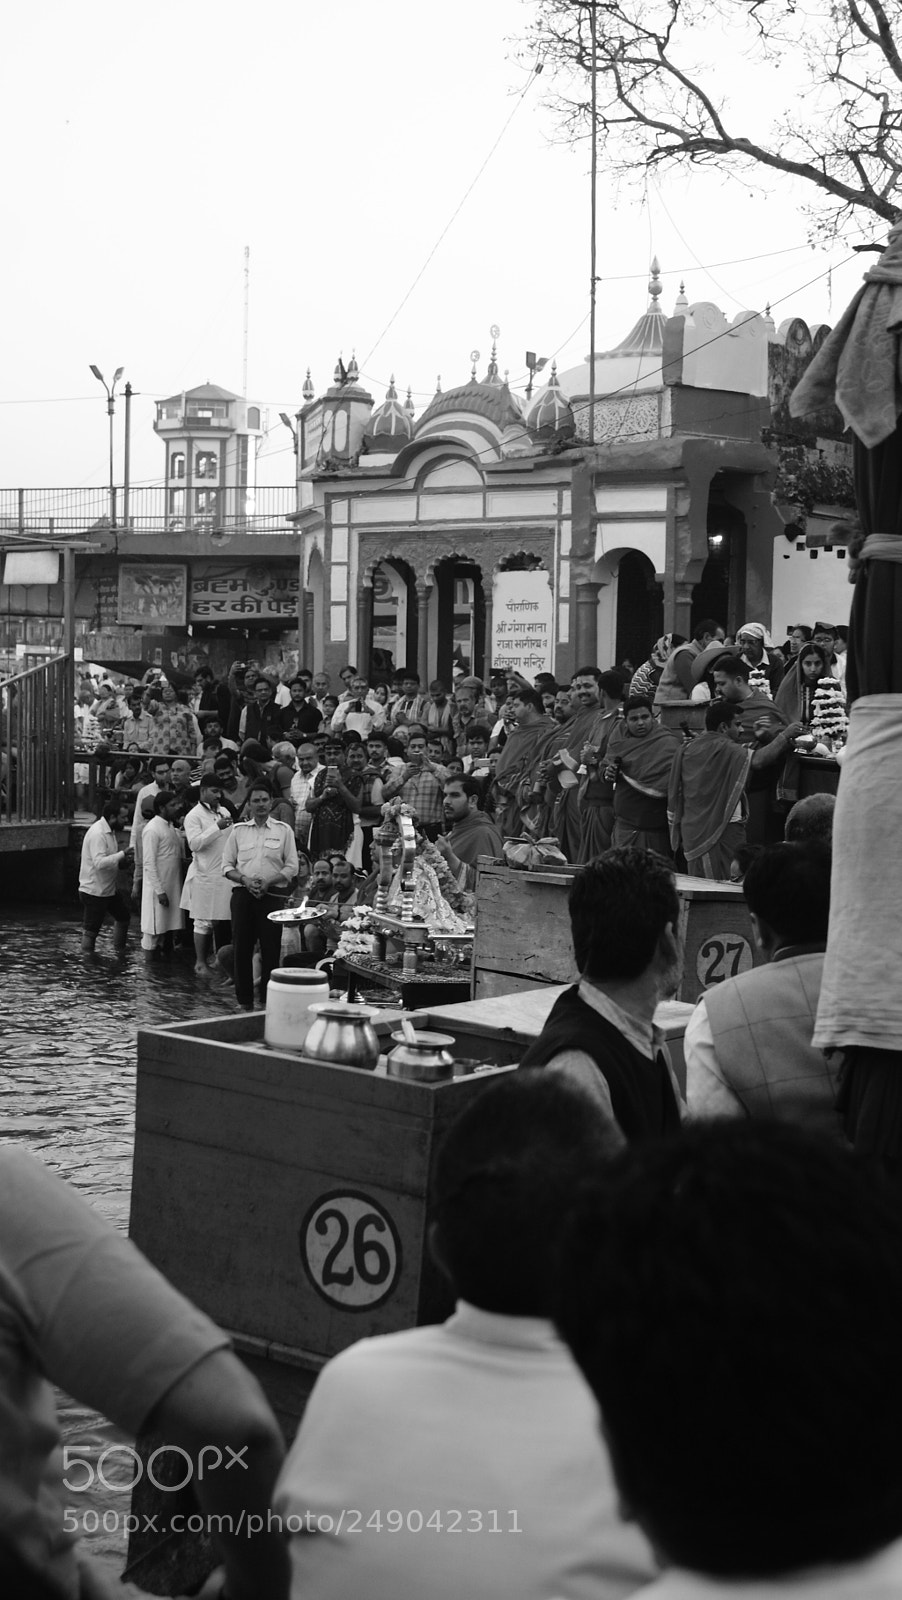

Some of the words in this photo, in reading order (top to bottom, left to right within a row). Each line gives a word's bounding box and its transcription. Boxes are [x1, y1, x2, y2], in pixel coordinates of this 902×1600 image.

[192, 600, 228, 616] हर
[230, 595, 262, 614] की
[505, 598, 539, 612] पौराणिक
[495, 620, 507, 633] श्री
[508, 619, 527, 633] गंगा
[527, 622, 547, 633] माता
[497, 639, 514, 650] राजा
[701, 940, 745, 985] 27
[315, 1208, 391, 1287] 26
